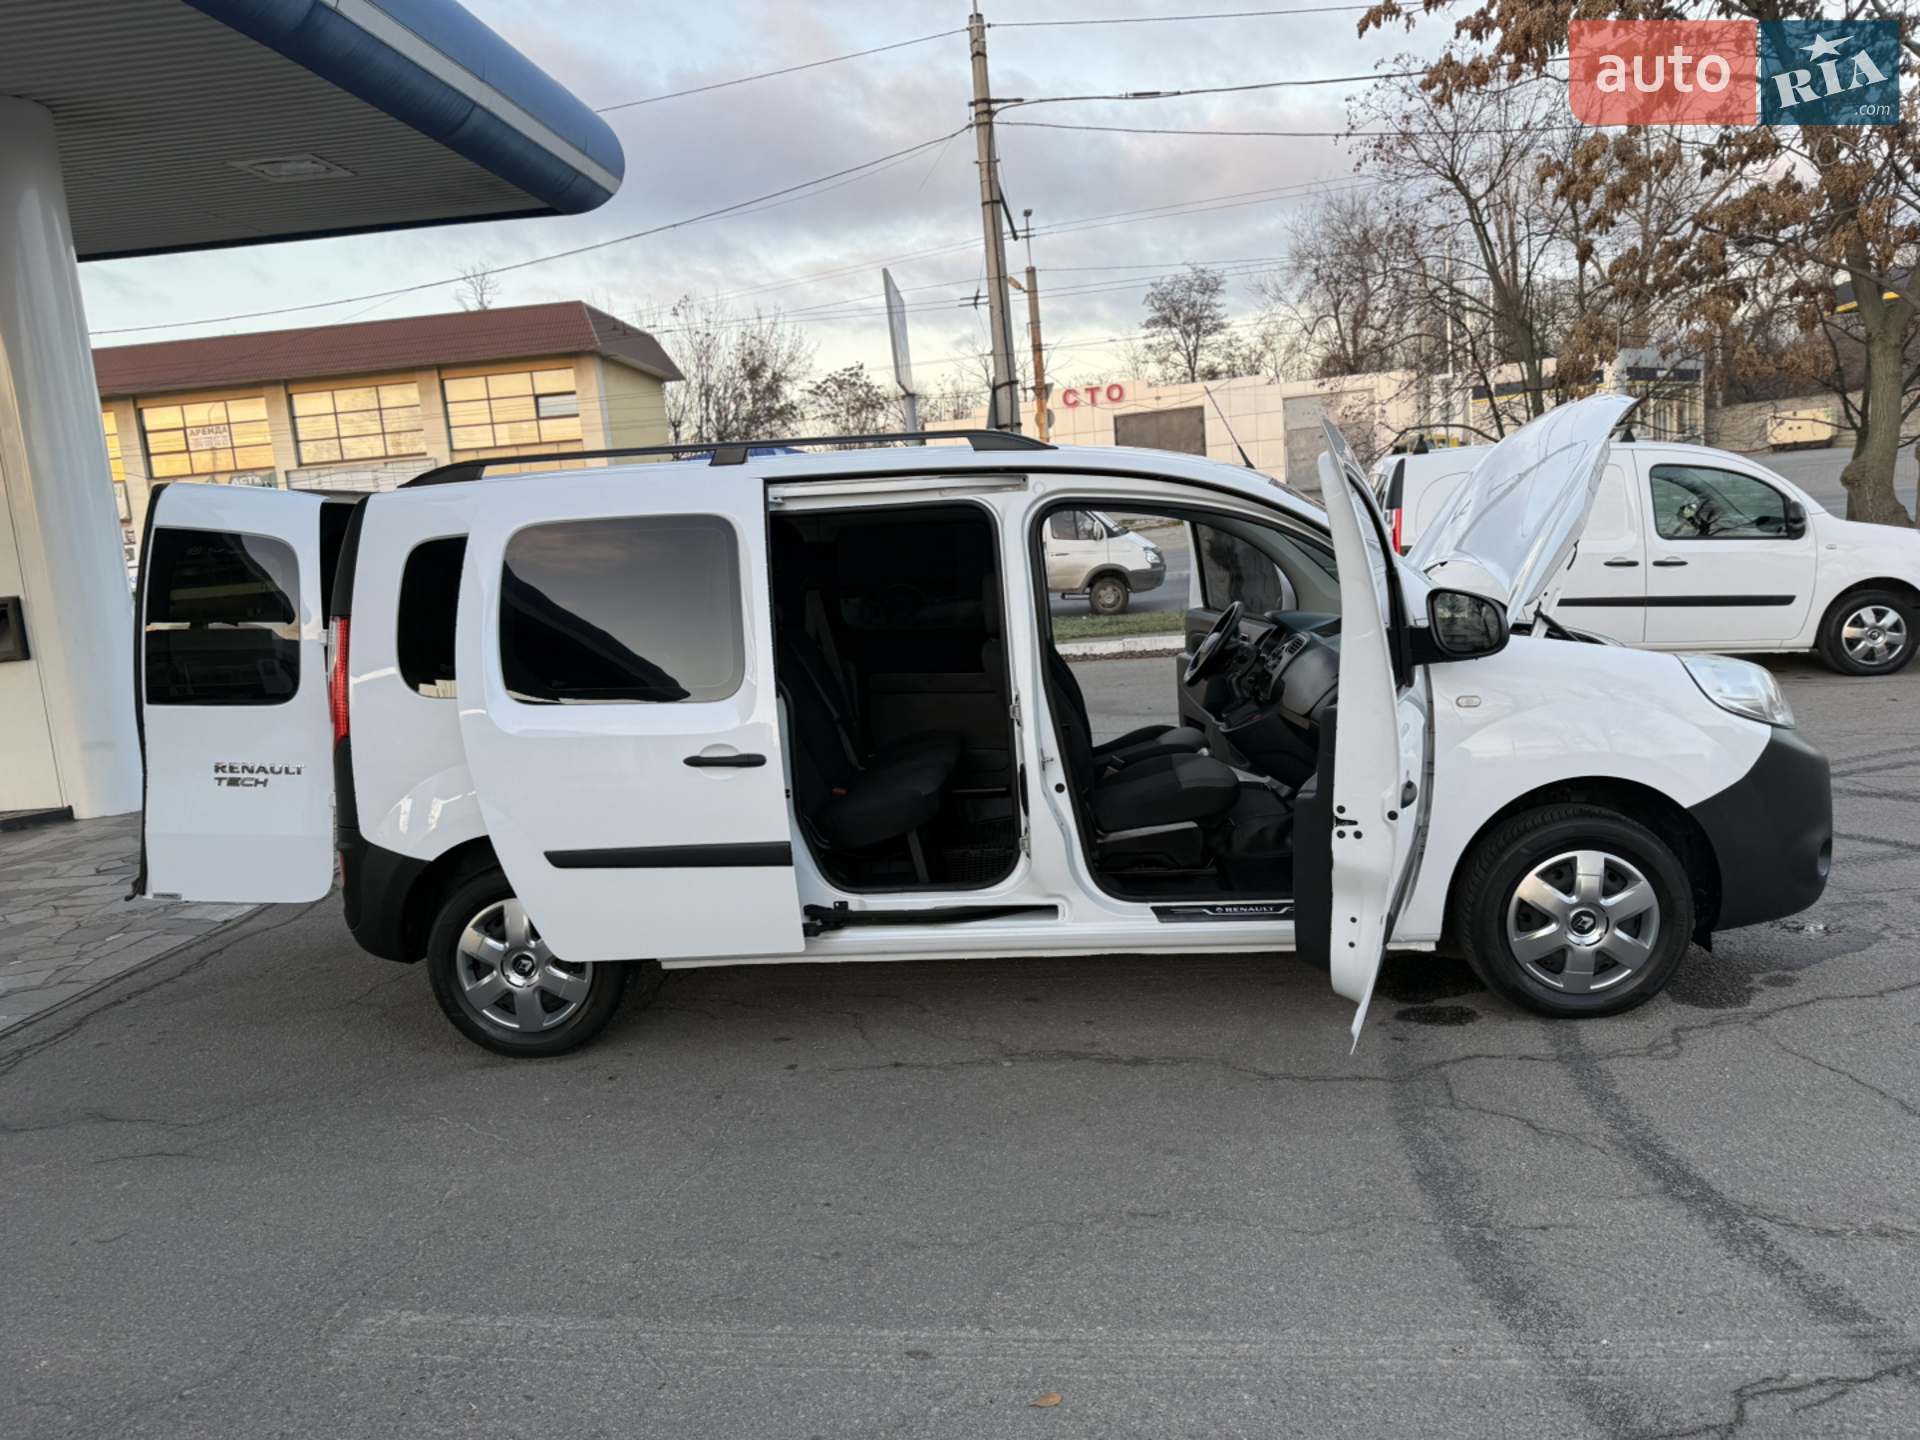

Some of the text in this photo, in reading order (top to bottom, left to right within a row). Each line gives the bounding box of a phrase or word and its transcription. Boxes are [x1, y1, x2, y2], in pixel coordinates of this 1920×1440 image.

[1062, 383, 1125, 408] СТО
[189, 426, 228, 437] АРЕНДА
[213, 762, 306, 775] RENAULT
[213, 777, 269, 787] TECH
